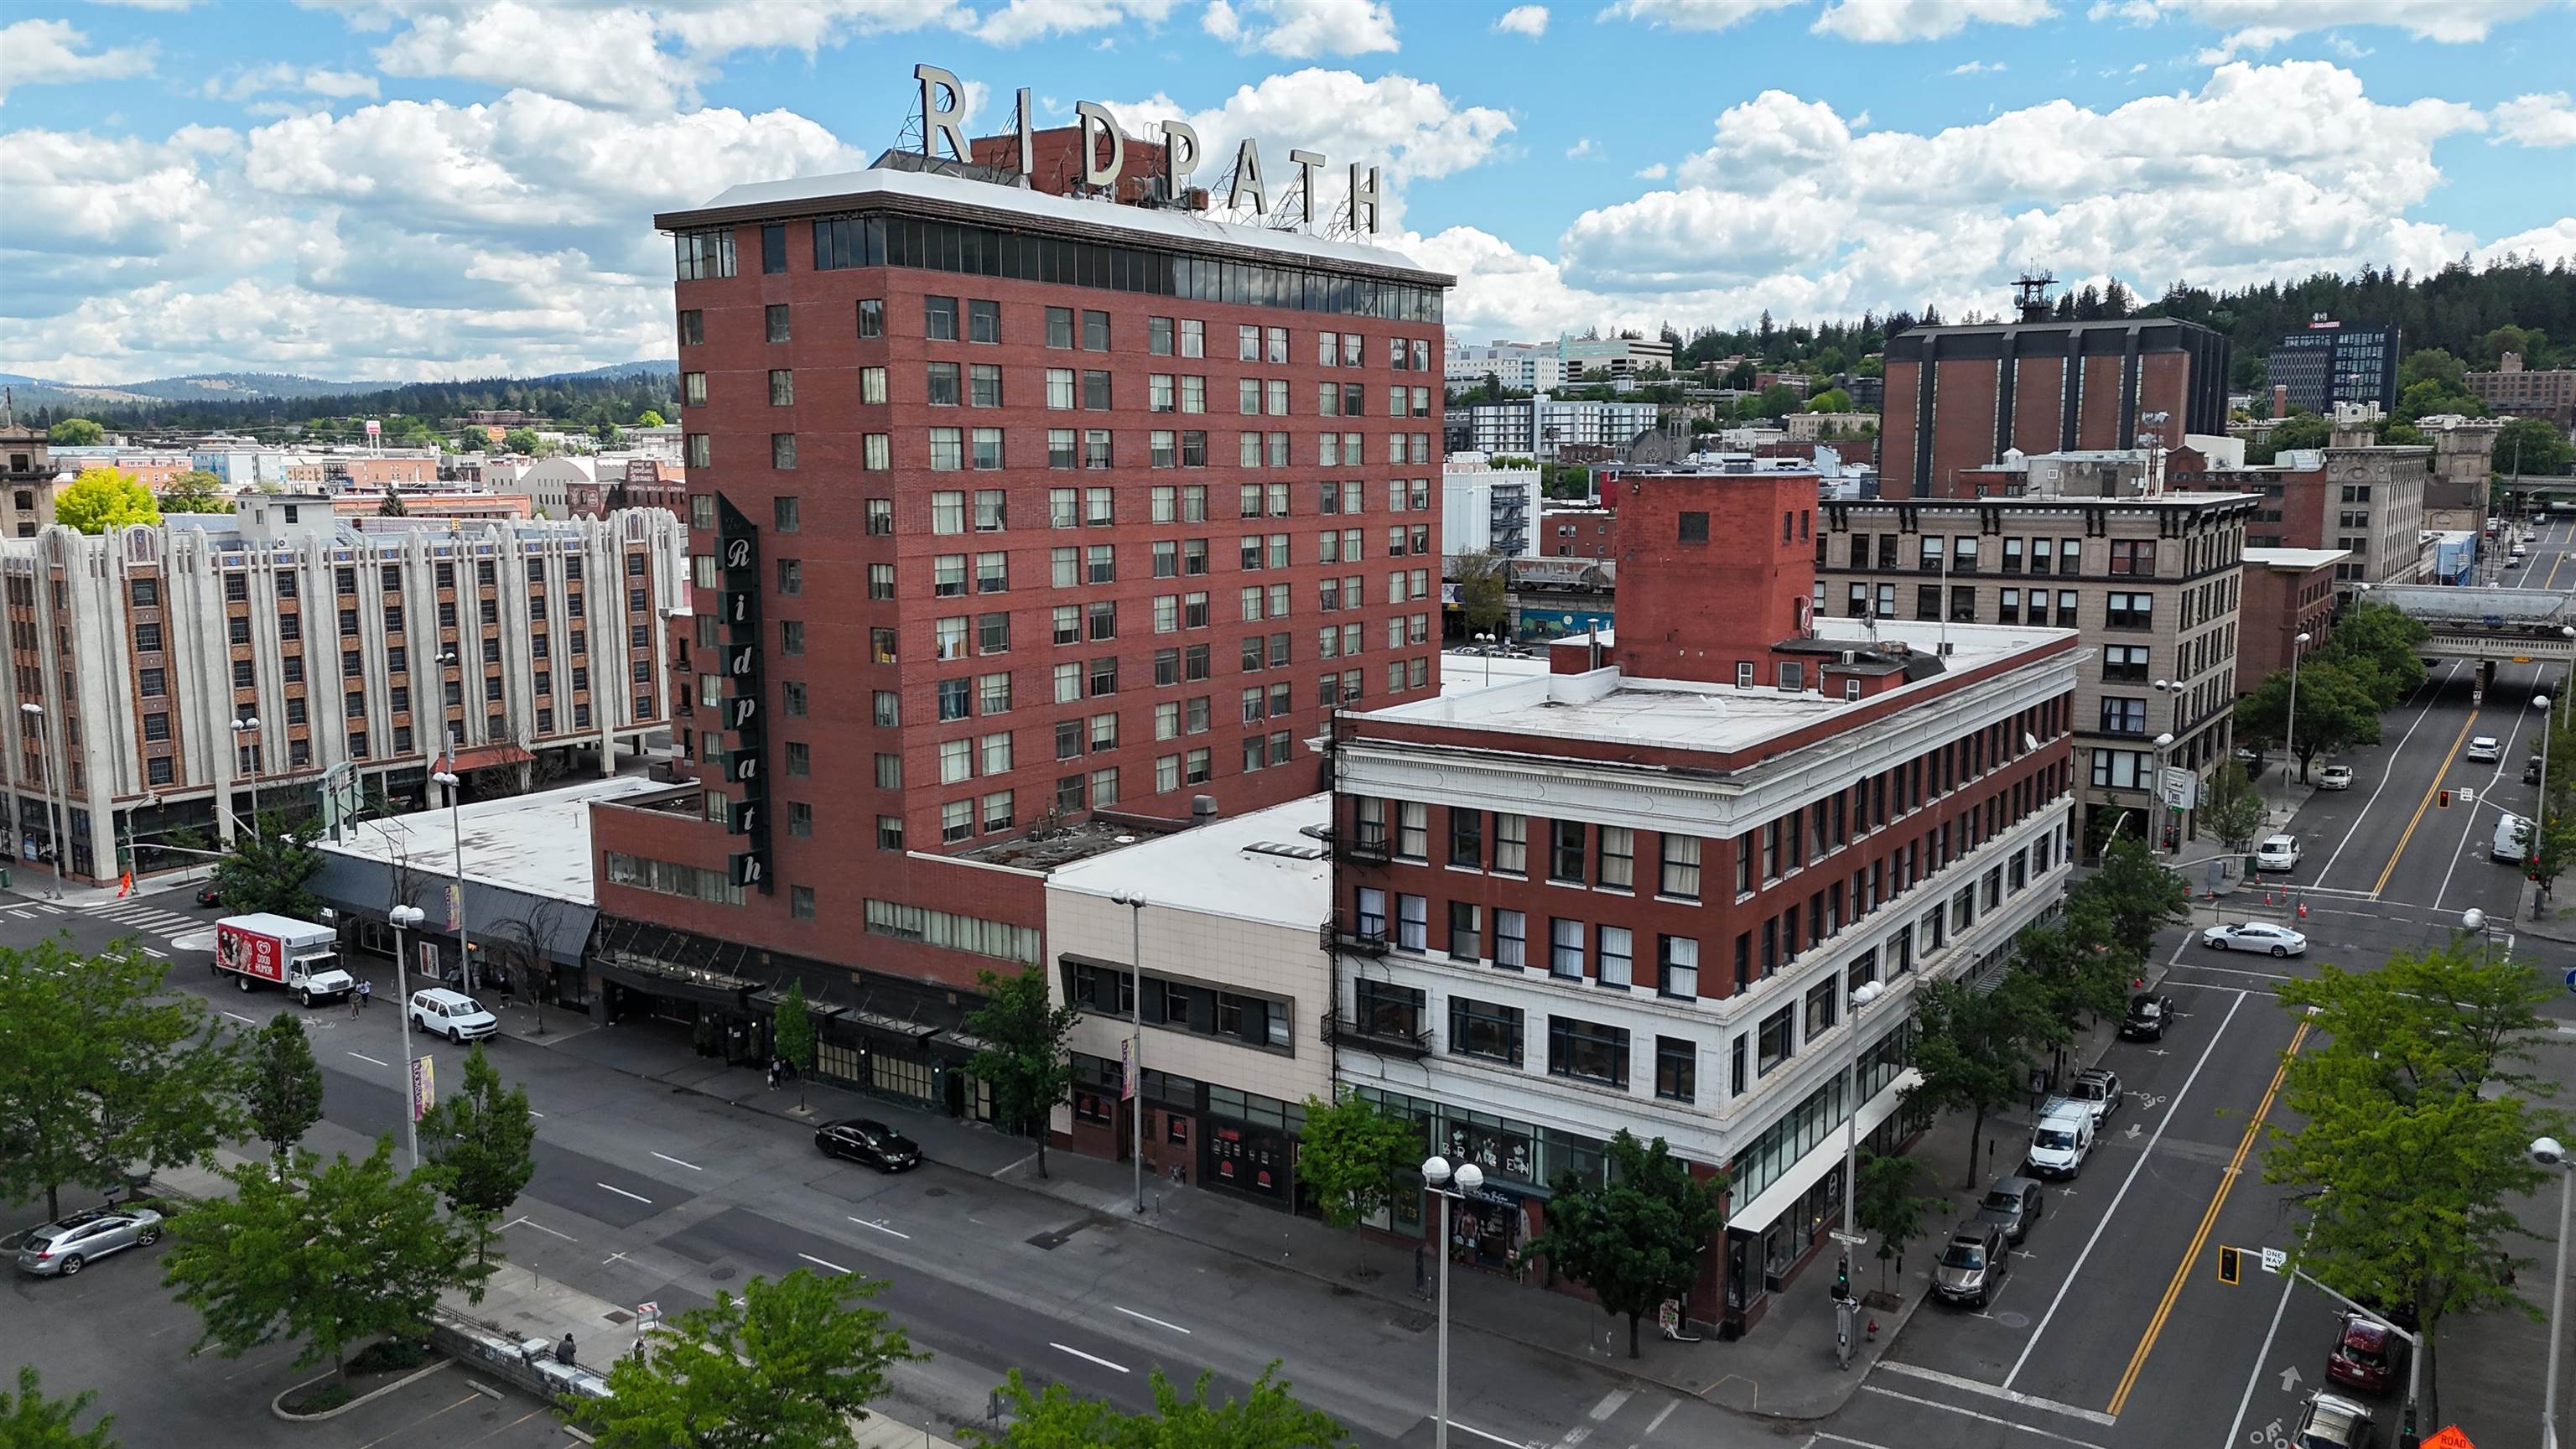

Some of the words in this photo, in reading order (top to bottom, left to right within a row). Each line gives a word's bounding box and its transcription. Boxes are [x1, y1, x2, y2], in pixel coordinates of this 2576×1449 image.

[913, 63, 1380, 234] RIDPATH
[727, 539, 761, 884] Ridpath
[257, 953, 271, 966] GOOD
[255, 962, 273, 974] HUMOR
[413, 1061, 423, 1105] BLOOMSDAY
[1442, 1142, 1530, 1175] BRAZEN
[2265, 1257, 2283, 1265] WAY
[2266, 1249, 2283, 1259] ONE
[2441, 1435, 2467, 1449] ROAD
